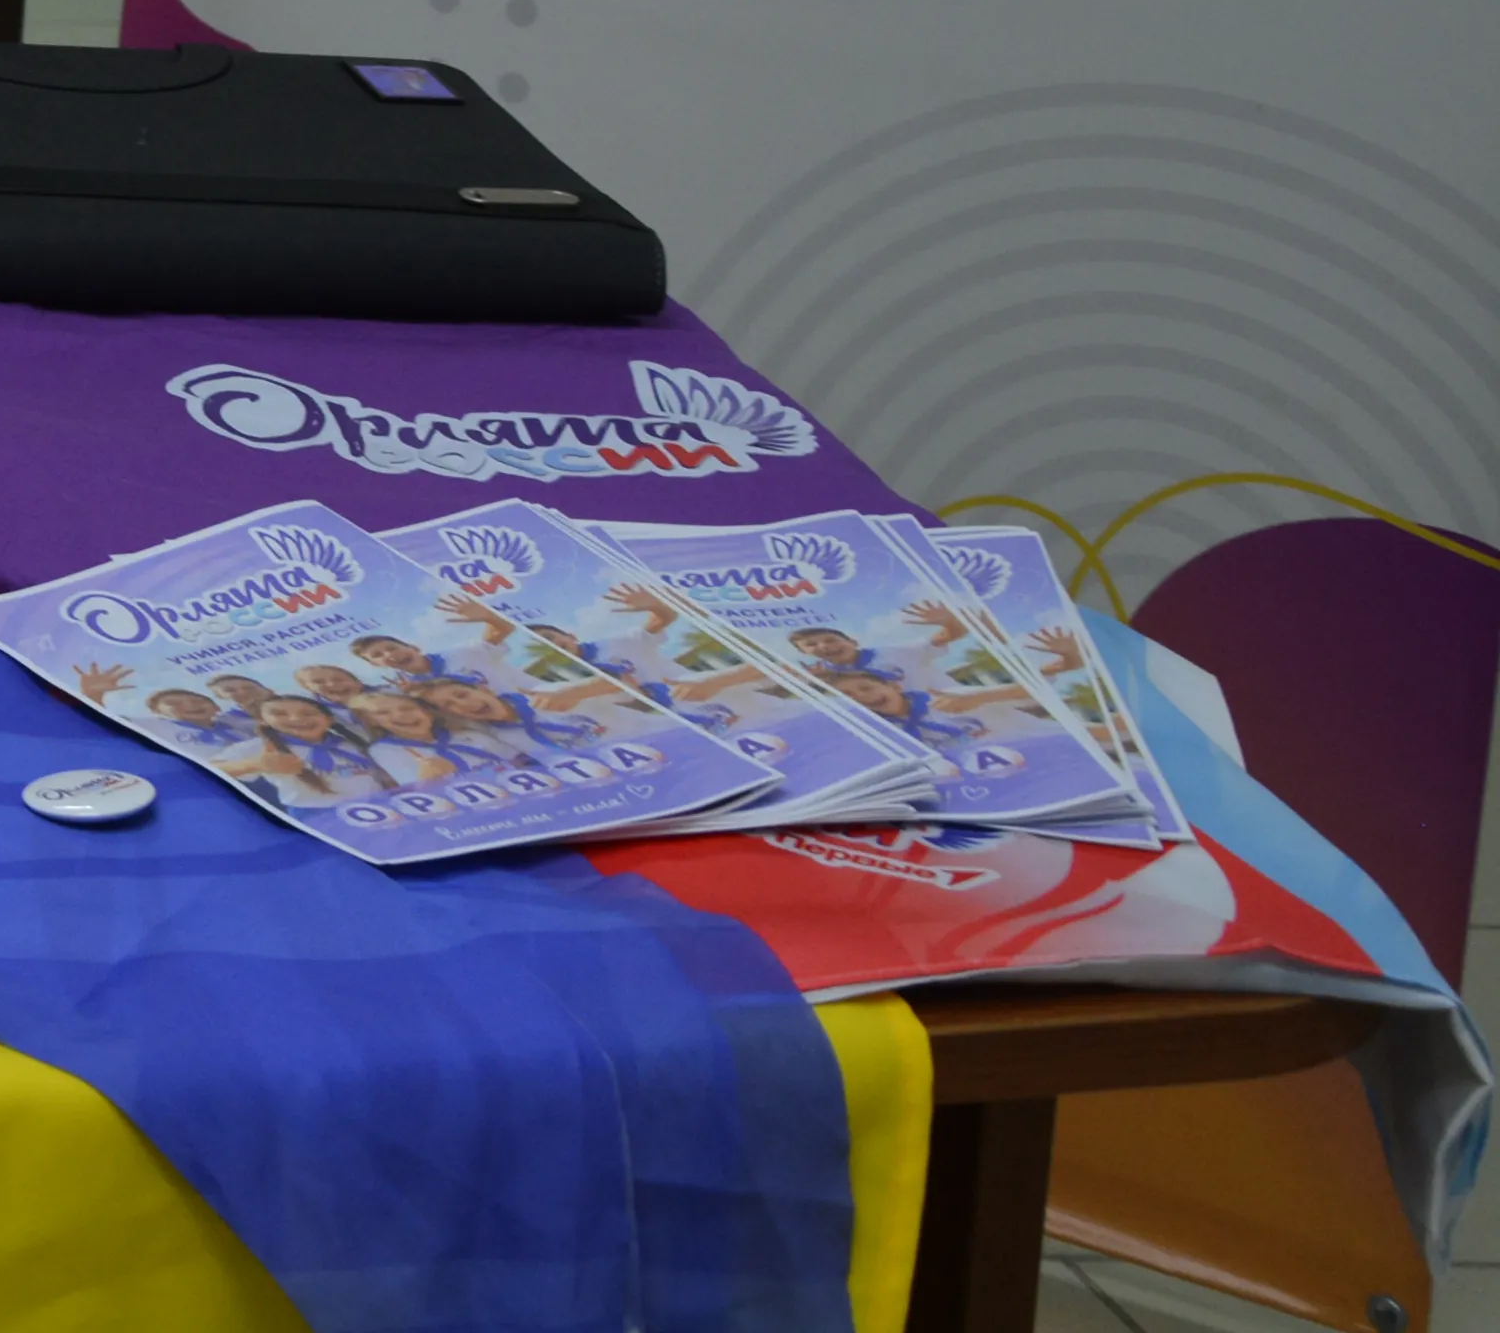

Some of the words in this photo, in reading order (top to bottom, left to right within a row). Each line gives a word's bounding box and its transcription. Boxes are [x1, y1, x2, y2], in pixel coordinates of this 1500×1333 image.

[182, 370, 713, 457] Орлята
[67, 566, 314, 643] Орлята
[167, 638, 265, 665] УЧИМСЯ,
[267, 613, 356, 643] РАСТЕМ,
[185, 647, 288, 675] МЕЧТАЕМ
[291, 617, 382, 652] ВМЕСТЕ!
